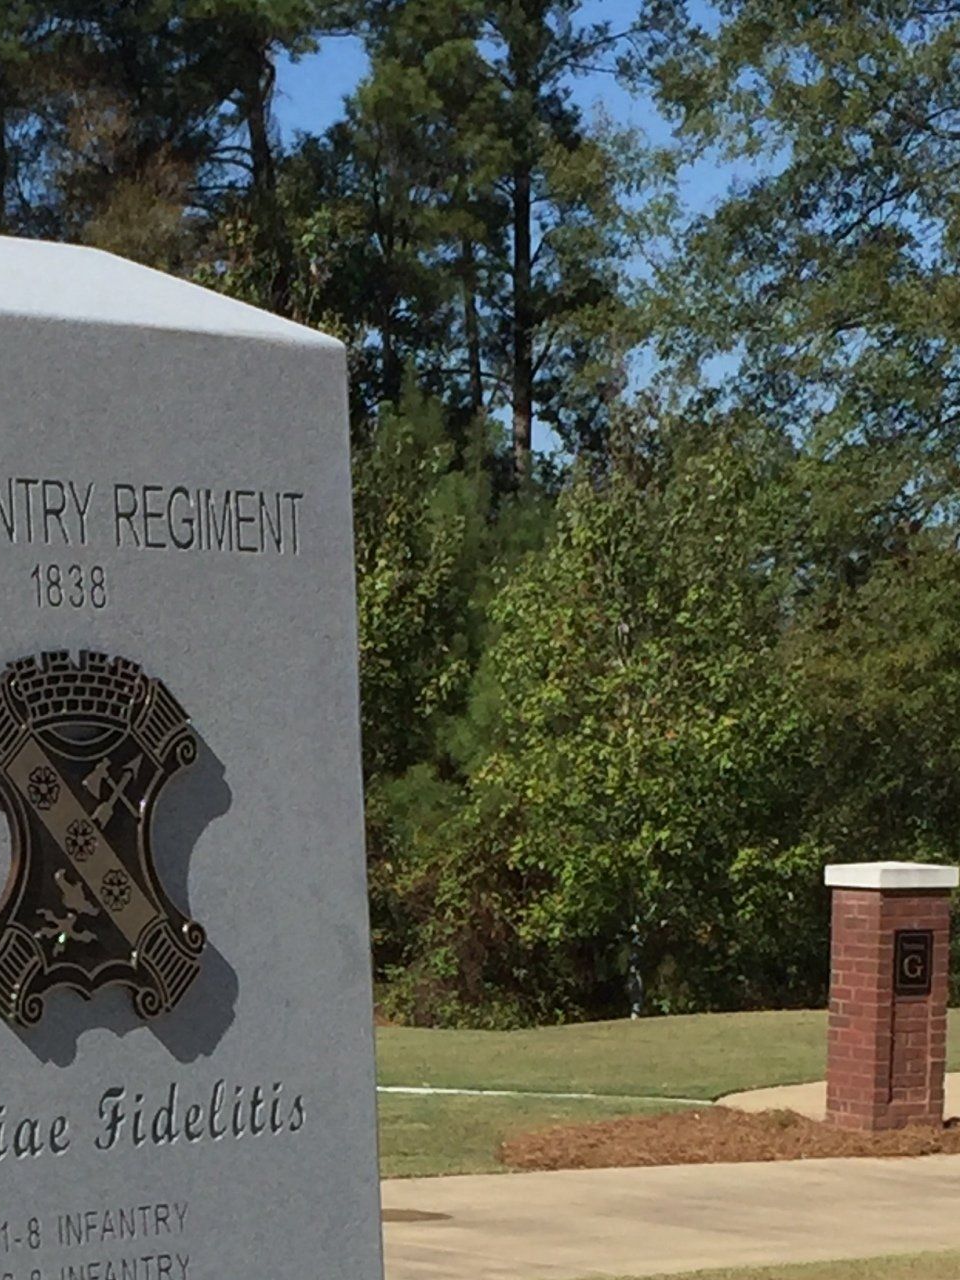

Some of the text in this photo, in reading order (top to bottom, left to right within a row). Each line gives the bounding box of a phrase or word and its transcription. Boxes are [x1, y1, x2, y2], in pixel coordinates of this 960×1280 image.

[114, 483, 304, 555] REGIMENT
[31, 564, 106, 609] 1838
[903, 954, 924, 978] G
[94, 1078, 307, 1150] Fidelitis
[0, 1203, 189, 1252] 1-8 INFANTRY
